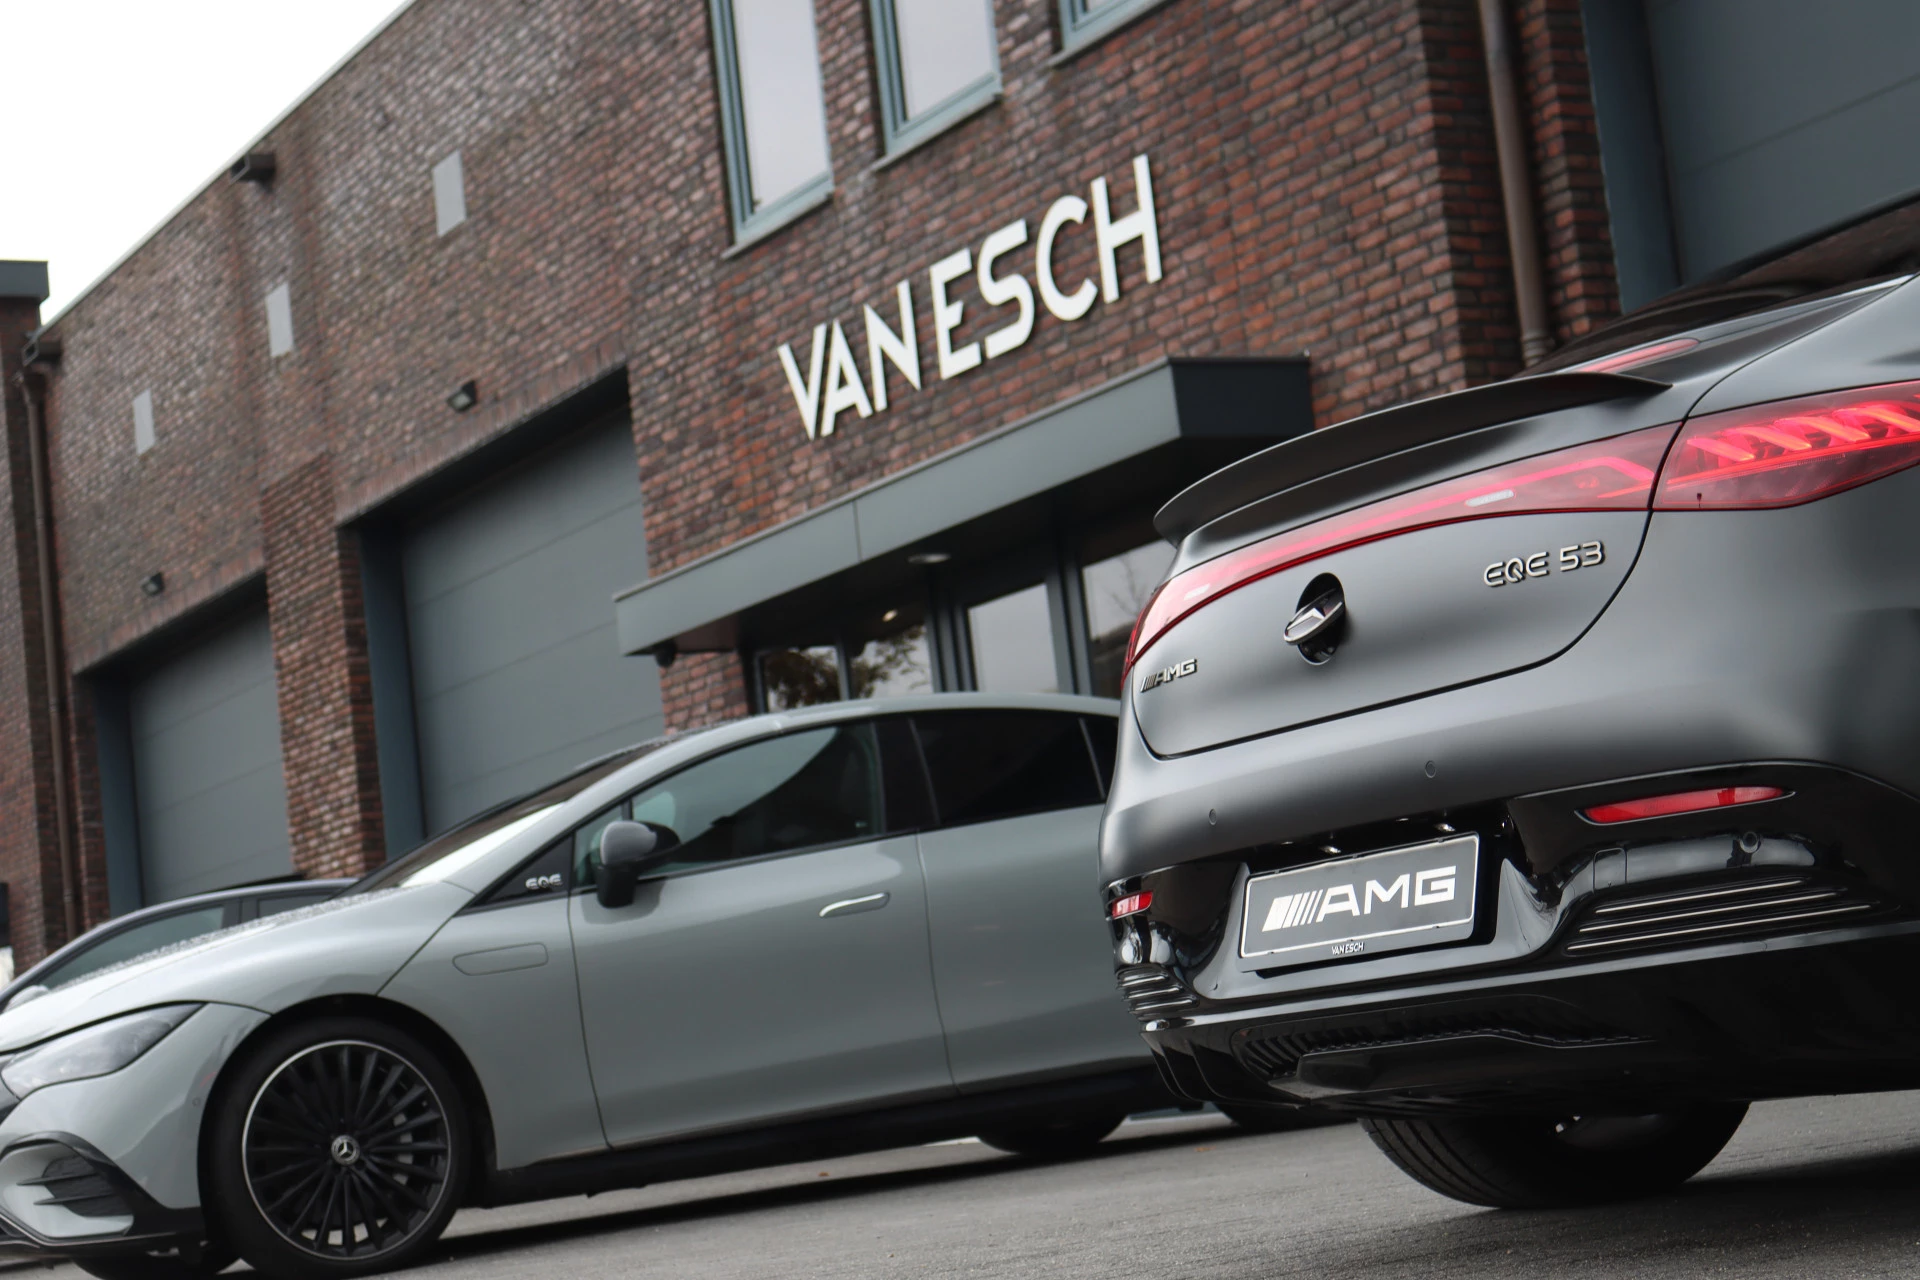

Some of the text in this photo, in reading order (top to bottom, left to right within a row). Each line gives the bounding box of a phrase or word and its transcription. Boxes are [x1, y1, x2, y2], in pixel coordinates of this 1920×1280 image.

[777, 153, 1163, 441] VAN ESCH
[1483, 540, 1604, 588] EQE 53
[525, 872, 562, 890] EQE
[1315, 865, 1457, 923] AMG
[1331, 941, 1365, 955] VAN ESCH
